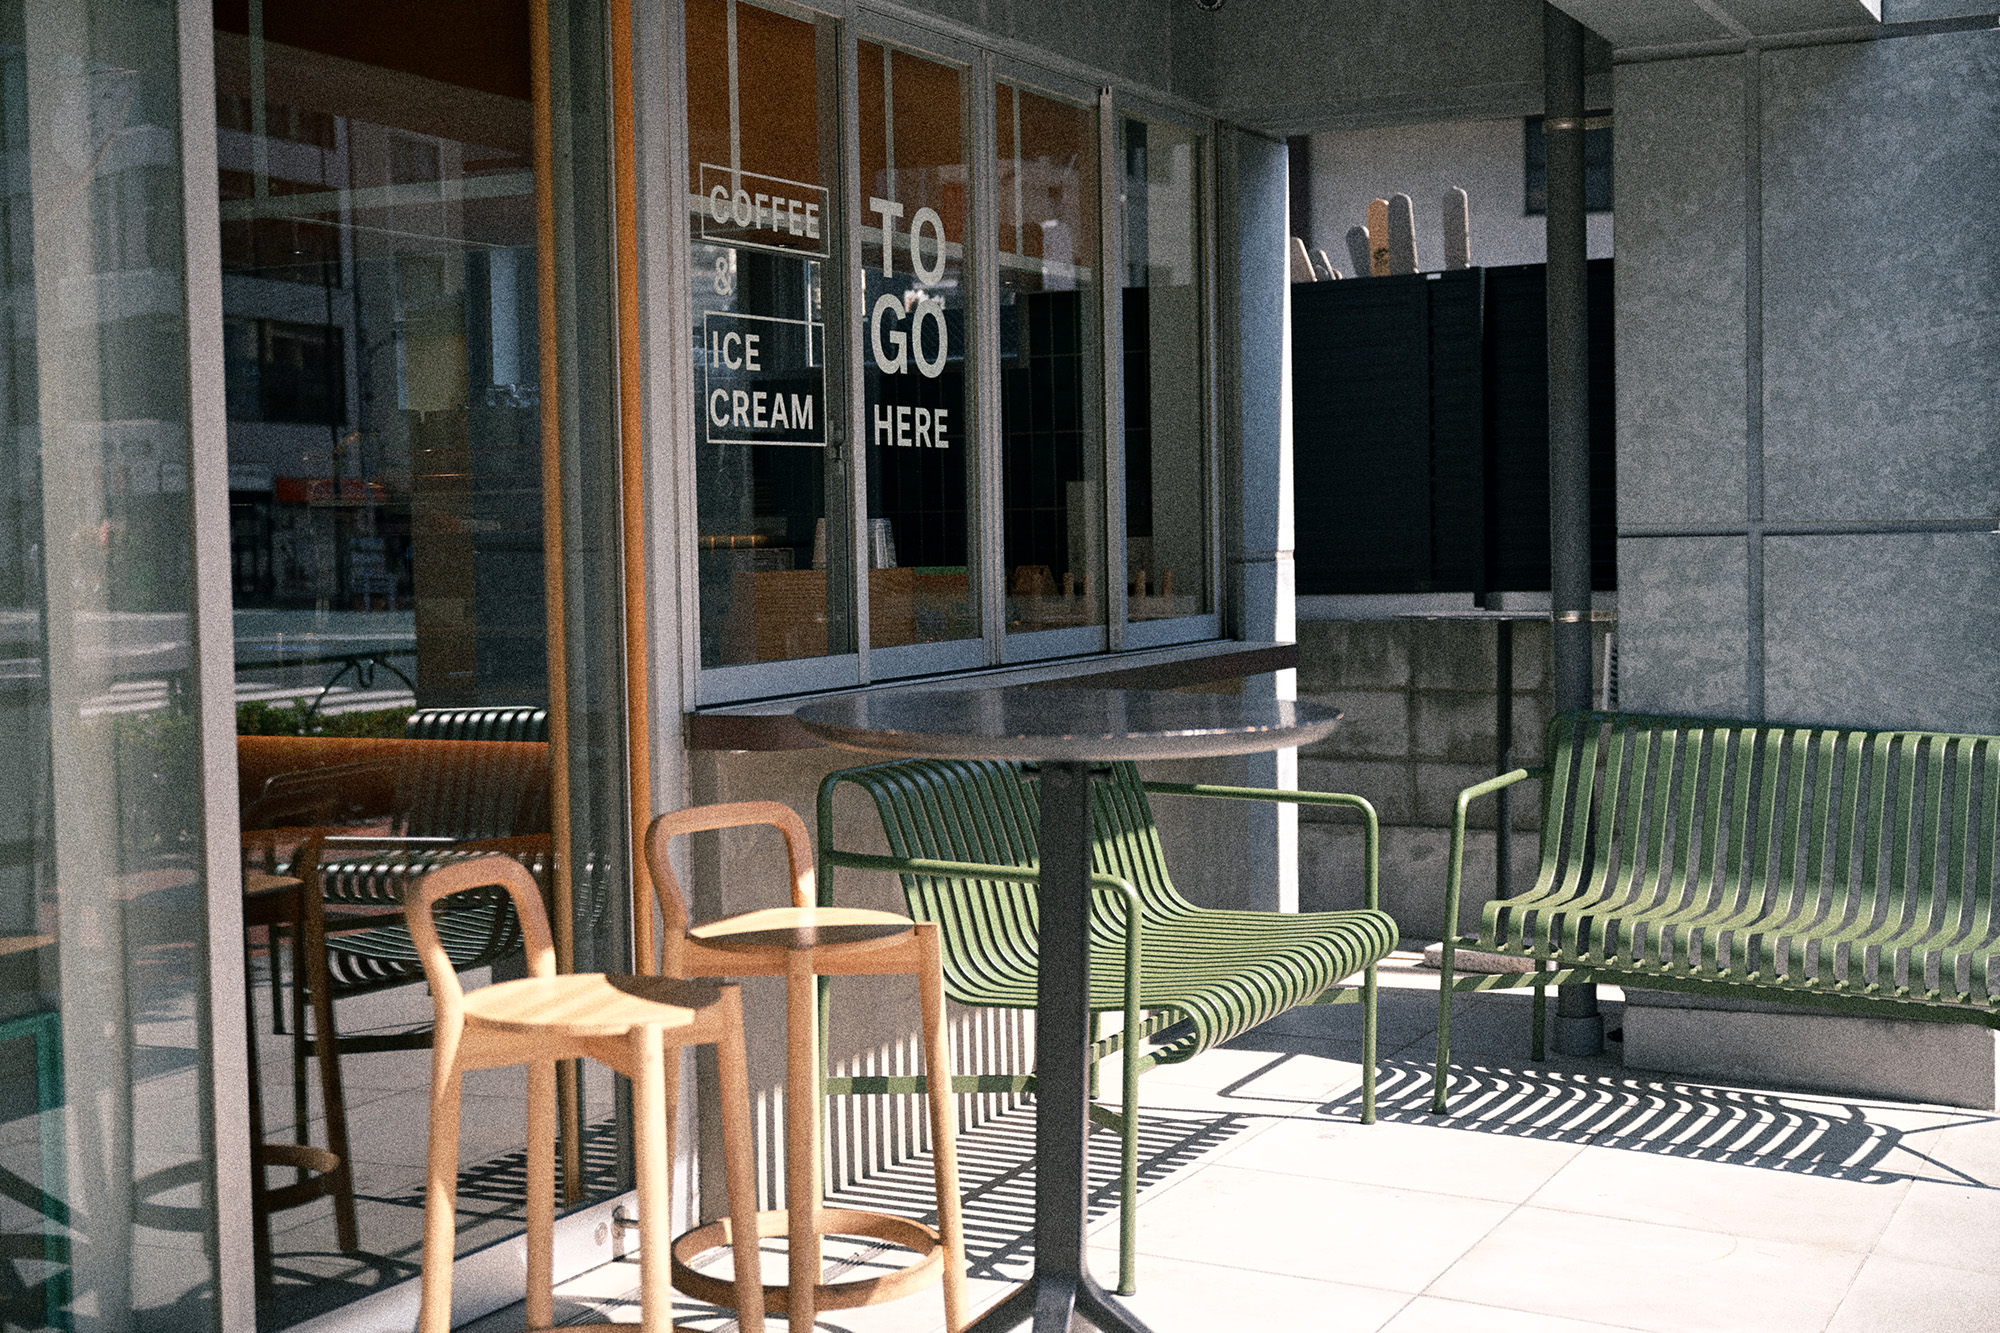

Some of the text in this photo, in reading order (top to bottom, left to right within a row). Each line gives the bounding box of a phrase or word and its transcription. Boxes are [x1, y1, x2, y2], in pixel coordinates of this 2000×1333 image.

[710, 185, 820, 239] COFFEE
[869, 196, 946, 286] TO
[715, 256, 732, 296] &
[712, 330, 761, 371] ICE
[871, 293, 948, 378] GO
[710, 388, 813, 430] CREAM
[874, 404, 949, 449] HERE
